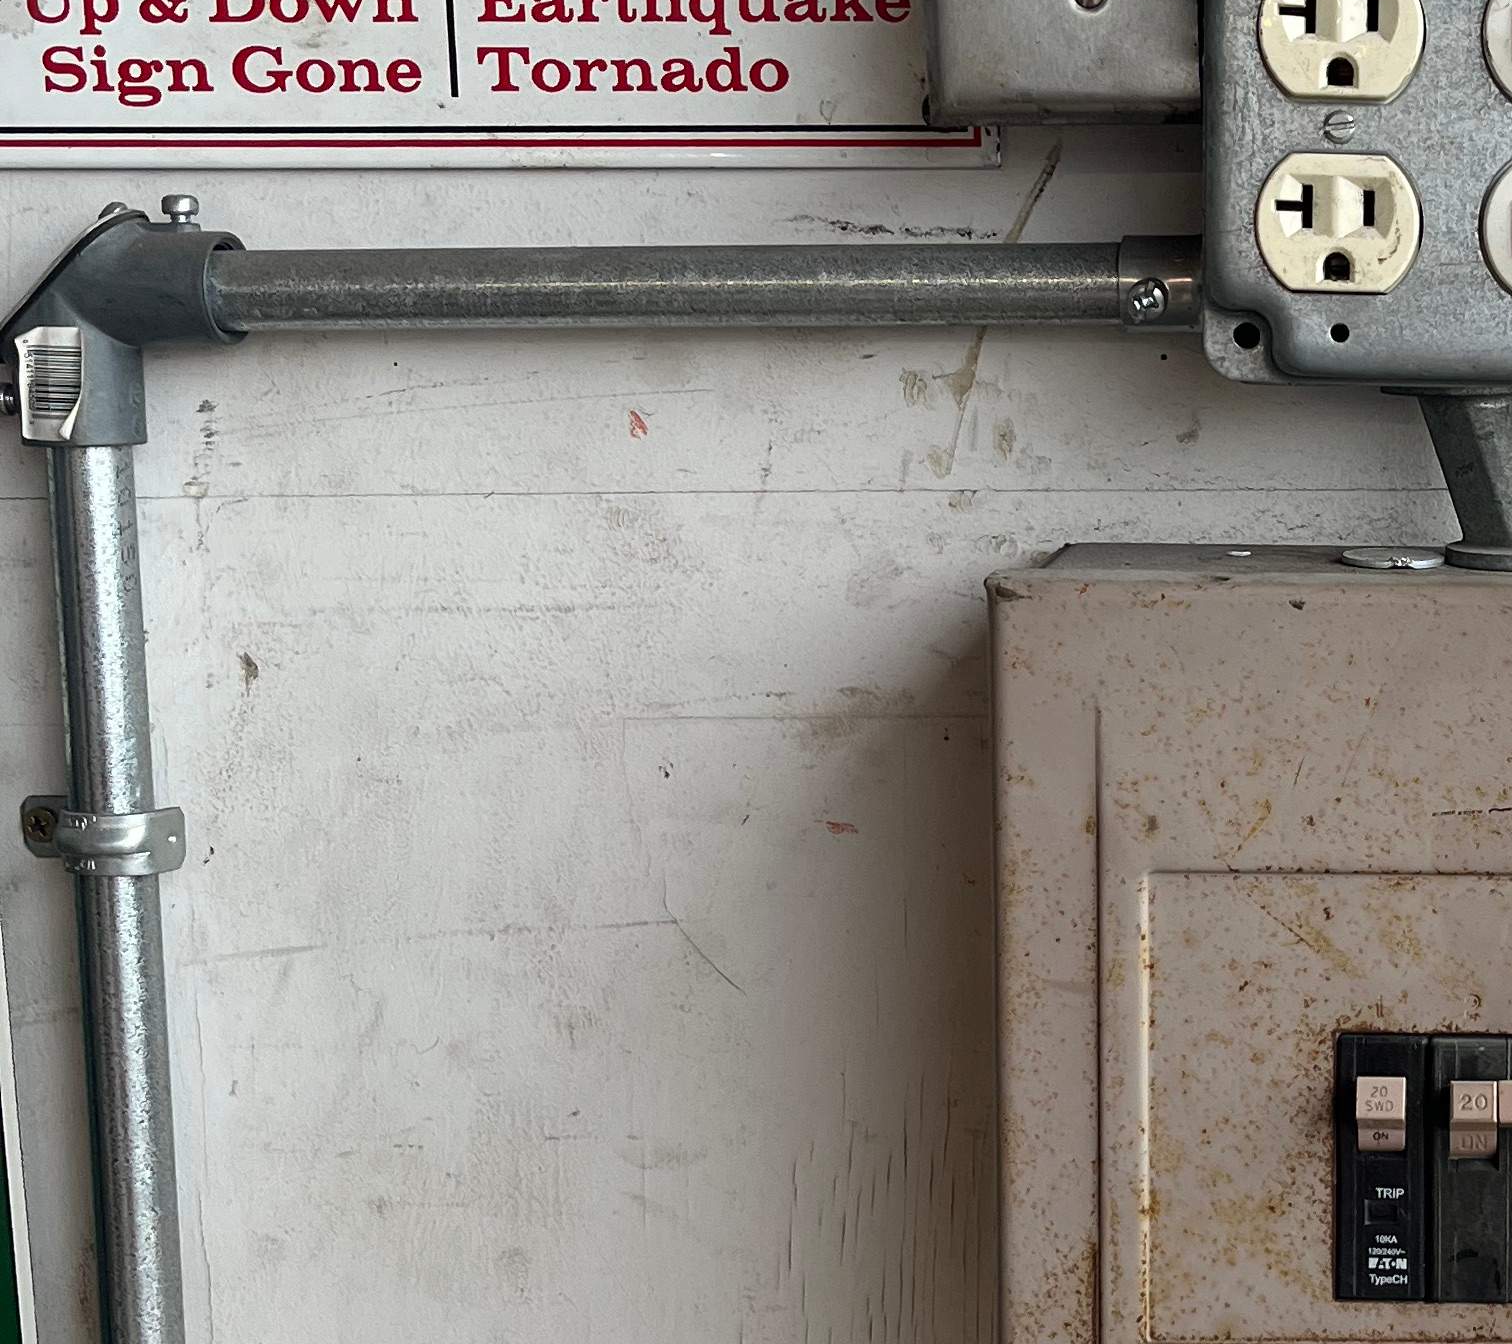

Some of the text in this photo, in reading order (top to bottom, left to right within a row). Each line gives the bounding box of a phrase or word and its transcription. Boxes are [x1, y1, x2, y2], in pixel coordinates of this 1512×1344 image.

[42, 45, 423, 107] Sign Gone
[476, 46, 790, 94] Tornado
[1370, 1086, 1389, 1098] 20
[1365, 1100, 1395, 1113] SWD
[1458, 1092, 1489, 1111] 20
[1459, 1134, 1489, 1152] ON
[1375, 1187, 1405, 1199] TRIP
